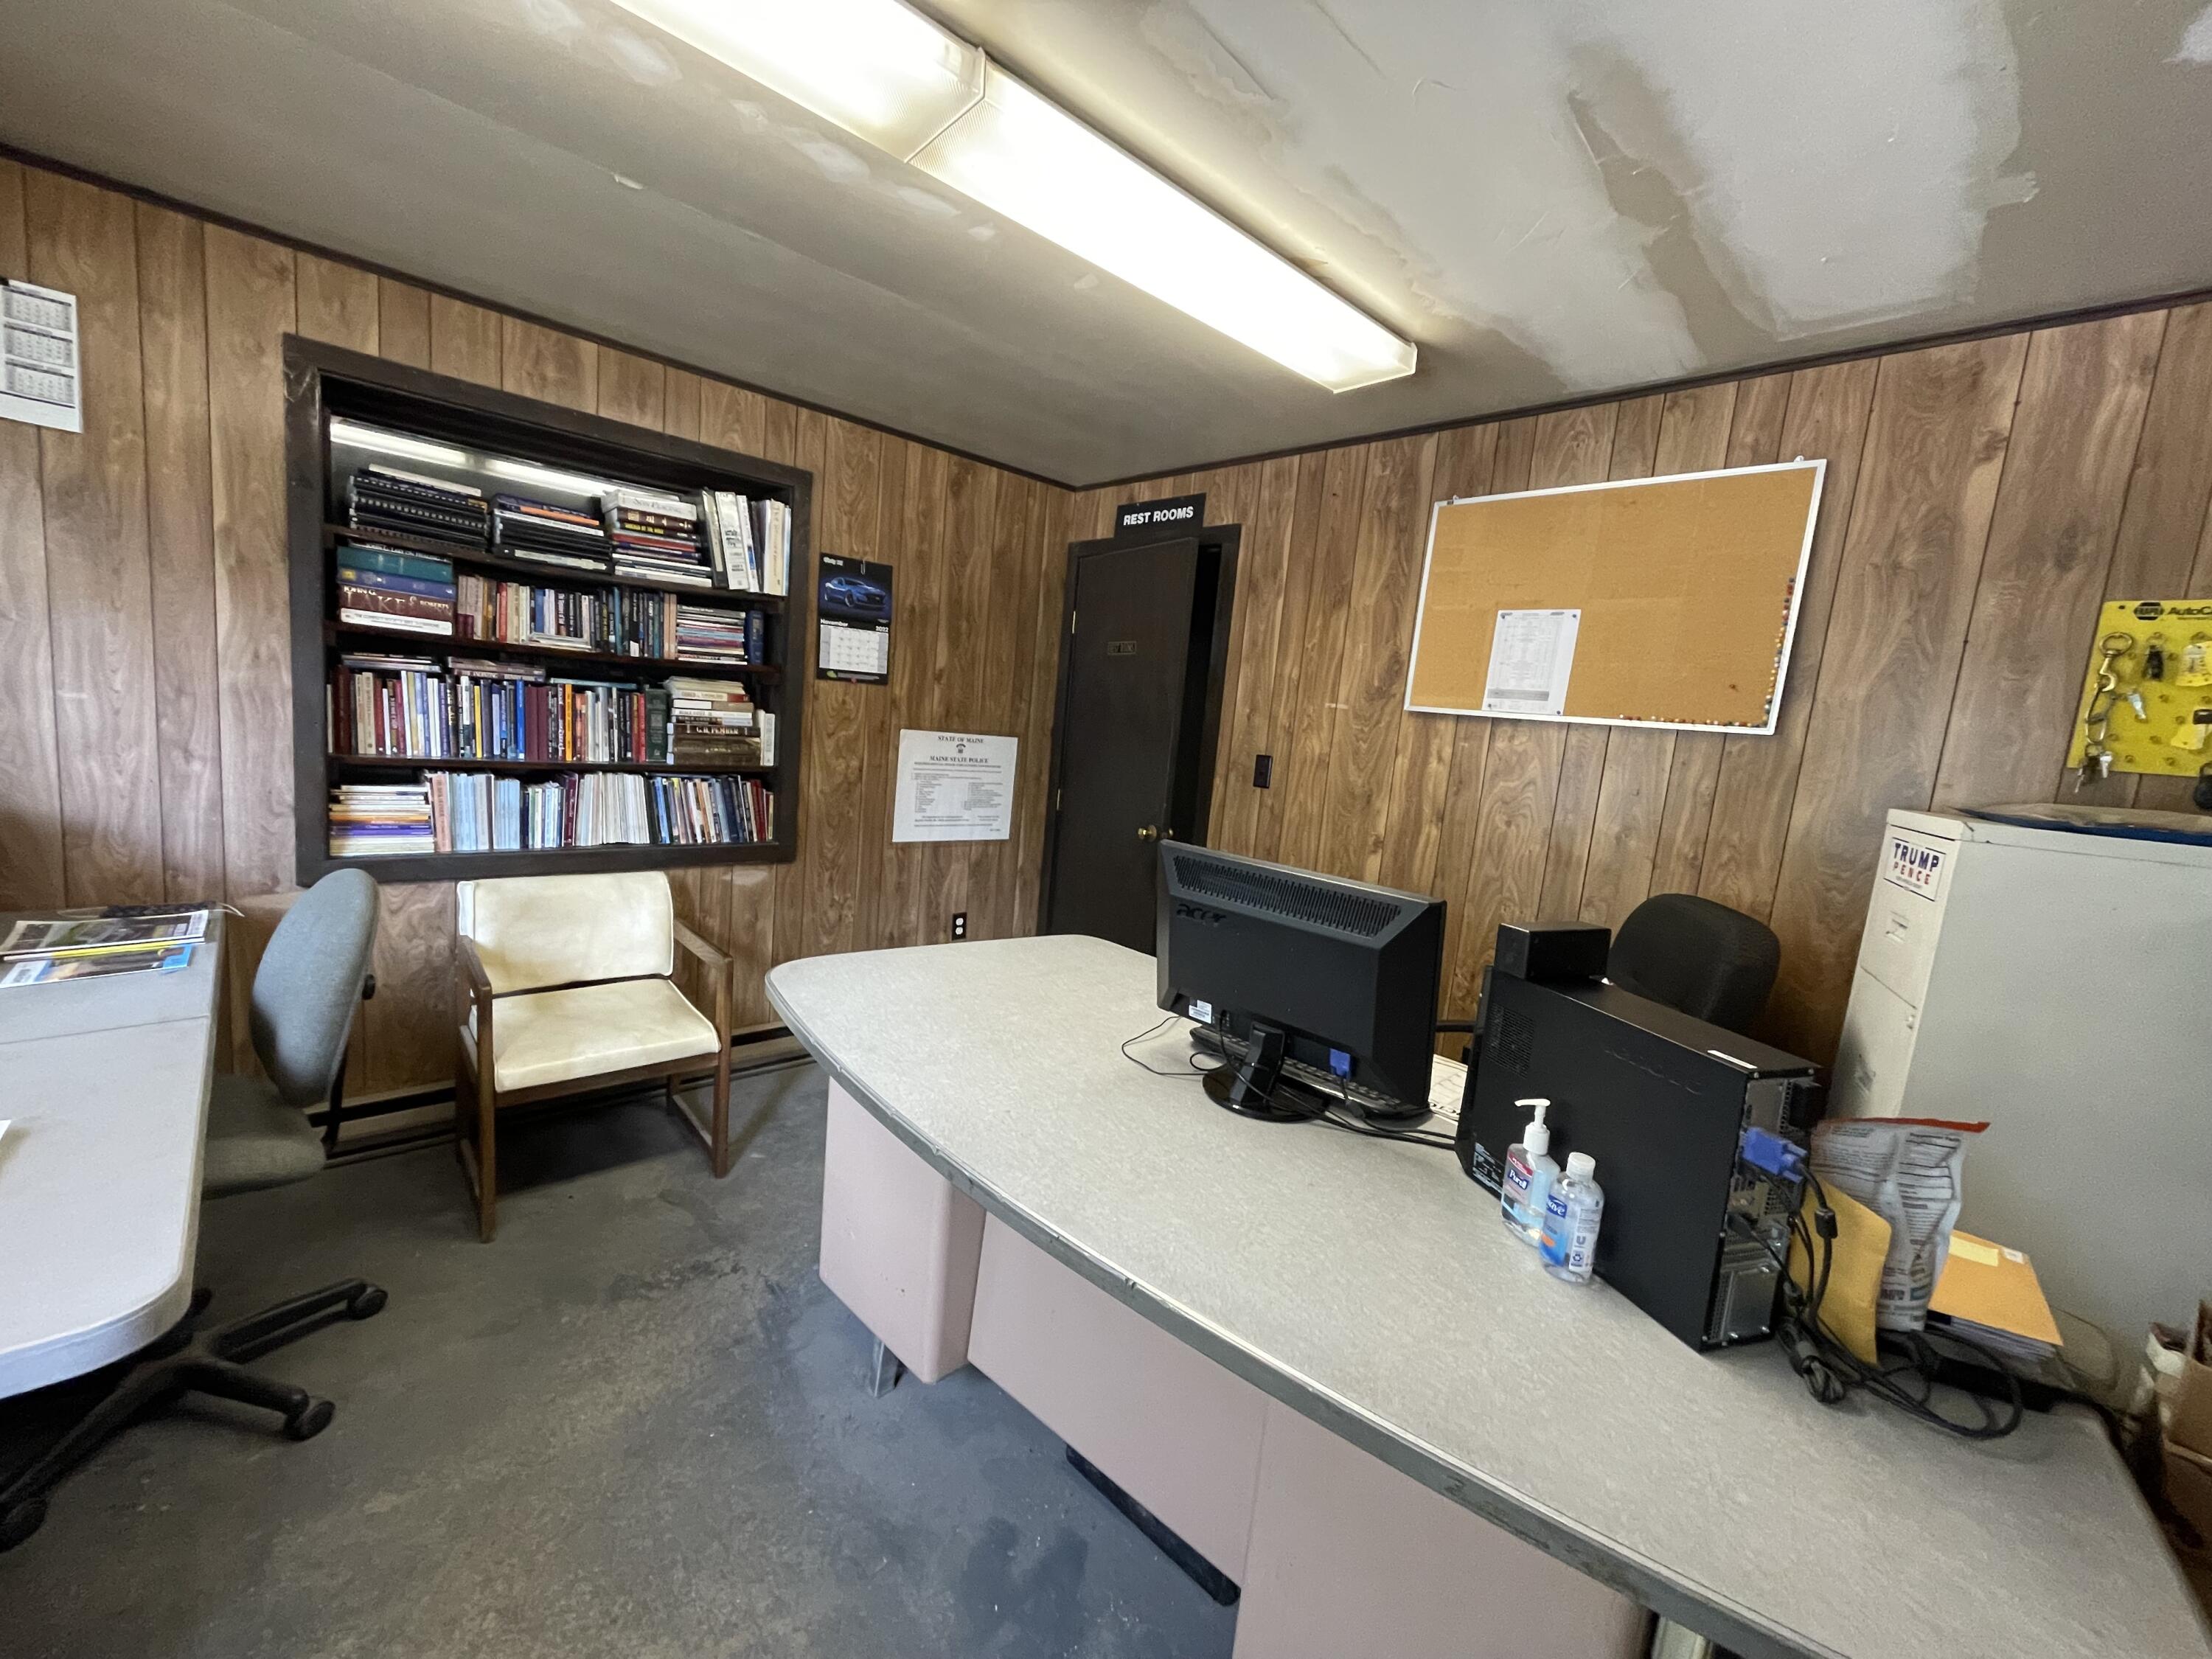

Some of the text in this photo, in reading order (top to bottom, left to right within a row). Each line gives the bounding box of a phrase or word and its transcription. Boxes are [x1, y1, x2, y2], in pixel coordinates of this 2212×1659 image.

[1123, 506, 1194, 526] REST ROOMS
[820, 618, 849, 627] November
[1893, 843, 1940, 872] TRUMP
[1893, 861, 1931, 885] PENCE
[1176, 903, 1227, 923] acer
[1509, 1169, 1527, 1190] Purell
